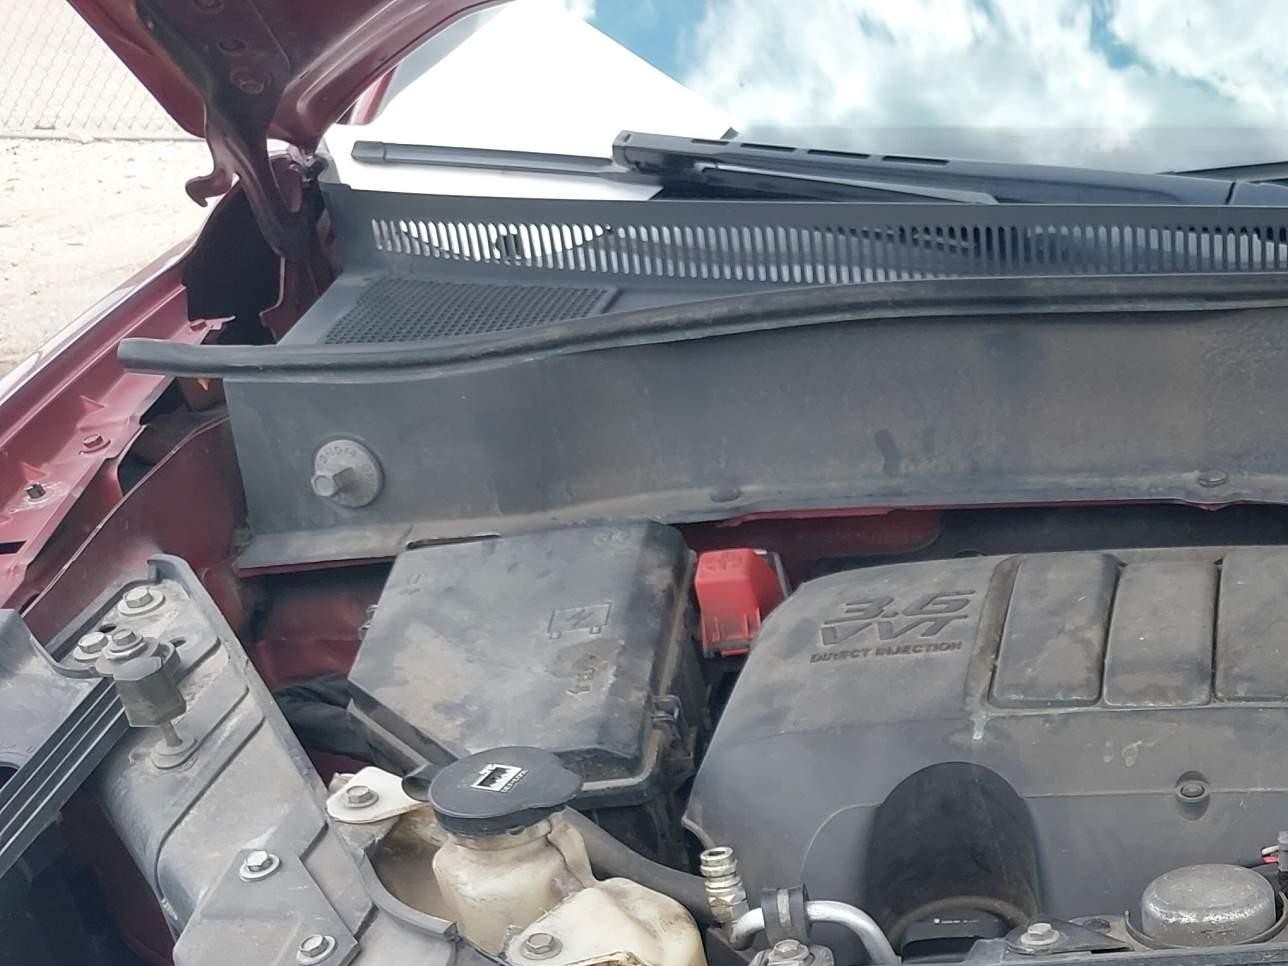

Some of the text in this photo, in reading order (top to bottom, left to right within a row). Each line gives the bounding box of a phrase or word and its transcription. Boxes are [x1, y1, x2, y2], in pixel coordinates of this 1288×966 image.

[842, 590, 977, 620] 3.6
[820, 615, 969, 646] VVT
[809, 641, 963, 664] DIRECT INJECTION
